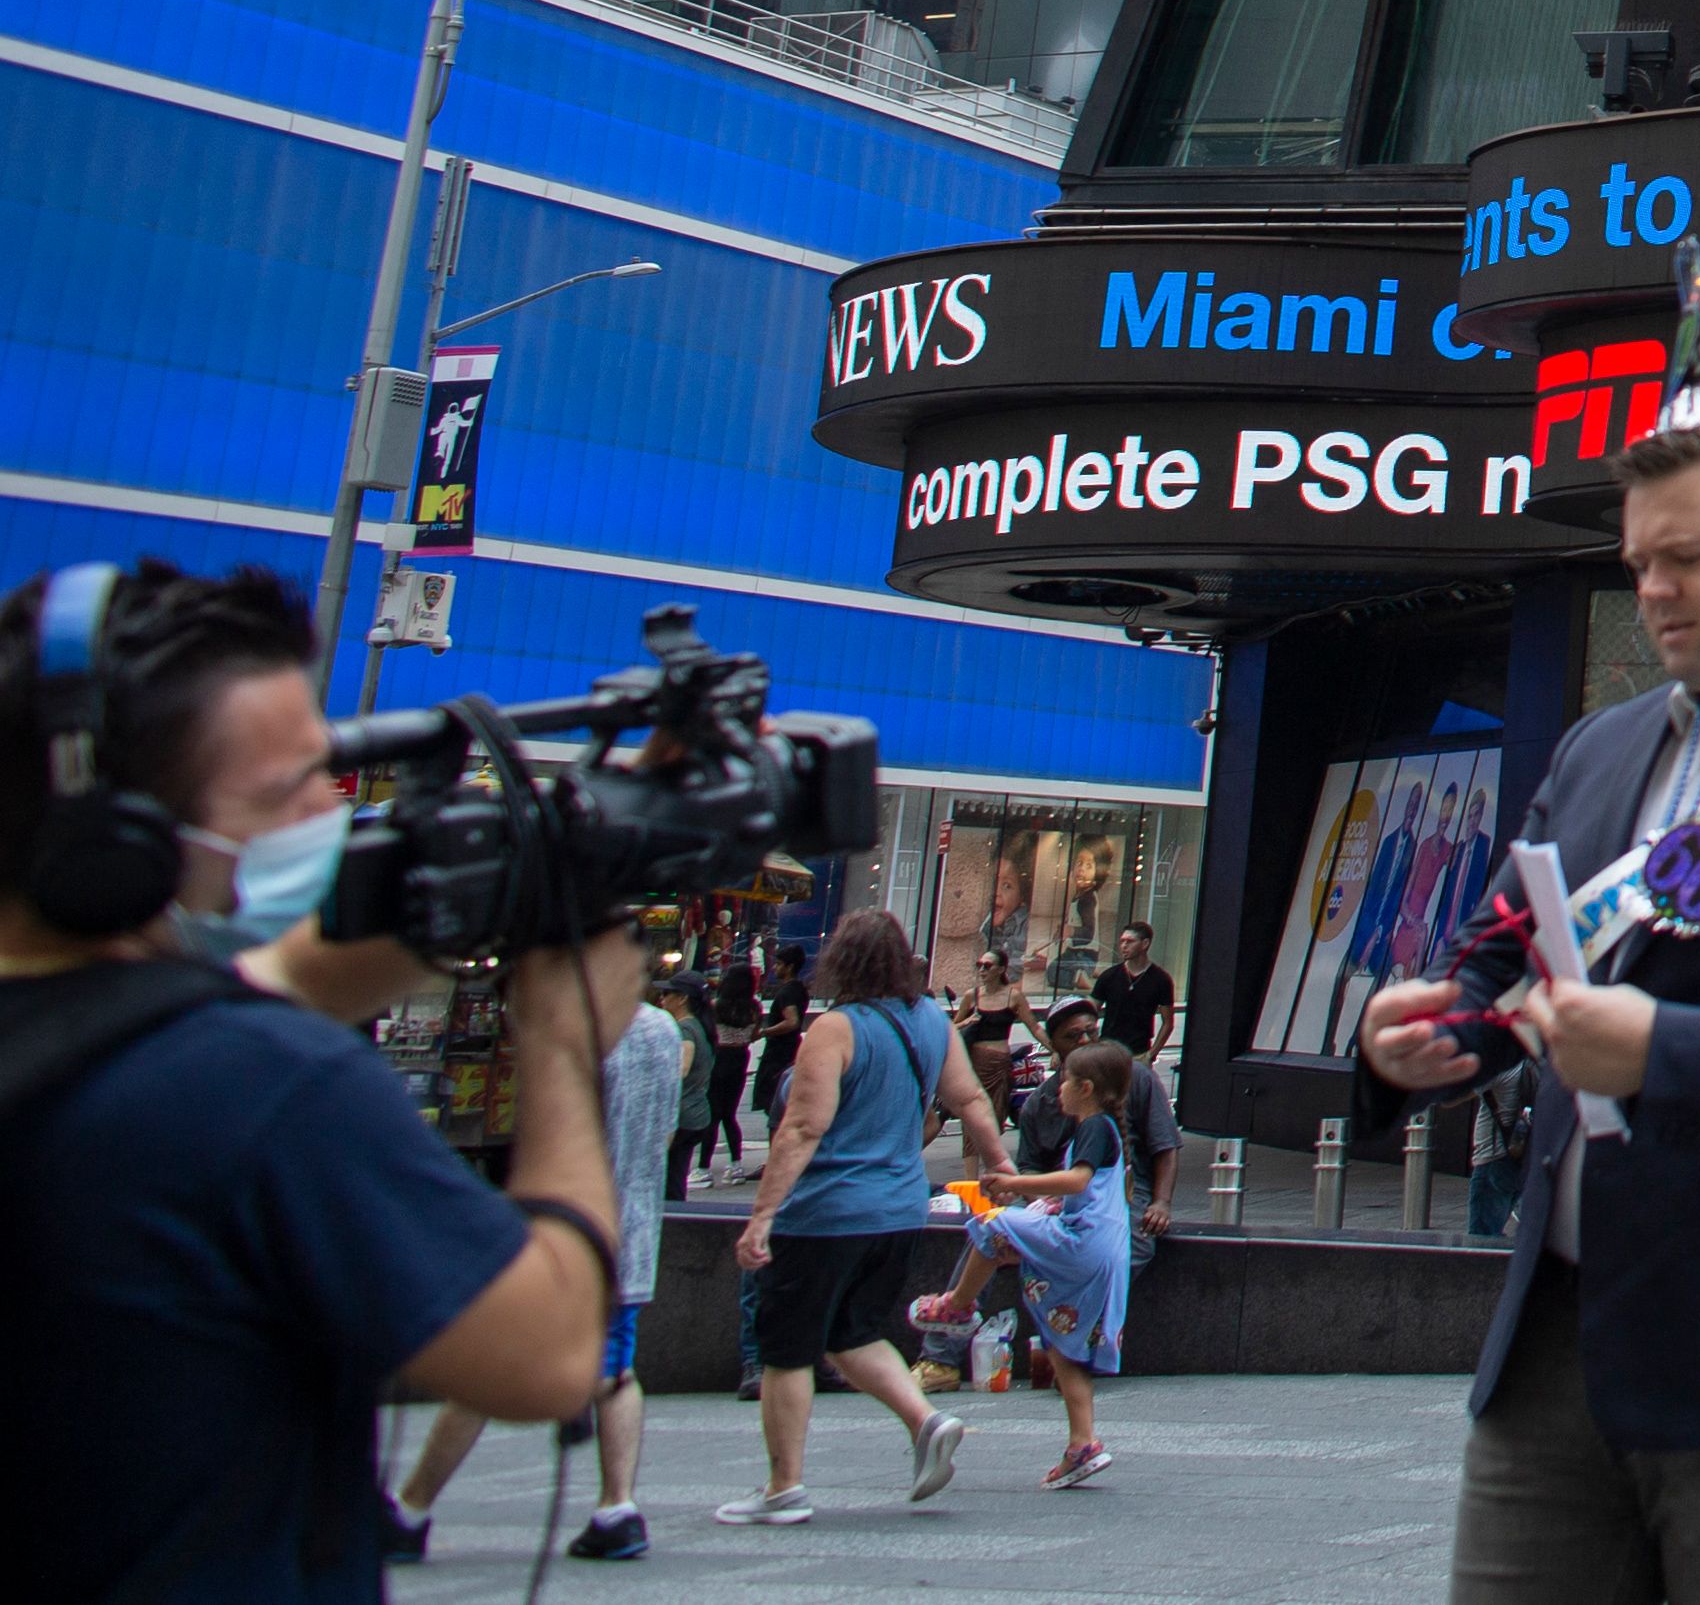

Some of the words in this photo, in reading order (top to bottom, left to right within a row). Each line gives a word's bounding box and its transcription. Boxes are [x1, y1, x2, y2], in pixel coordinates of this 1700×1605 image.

[1601, 163, 1692, 247] to
[828, 273, 992, 387] NEWS
[1099, 271, 1398, 359] Miami
[418, 483, 471, 522] MTV
[906, 434, 1199, 536] complete
[1231, 430, 1449, 516] PSG
